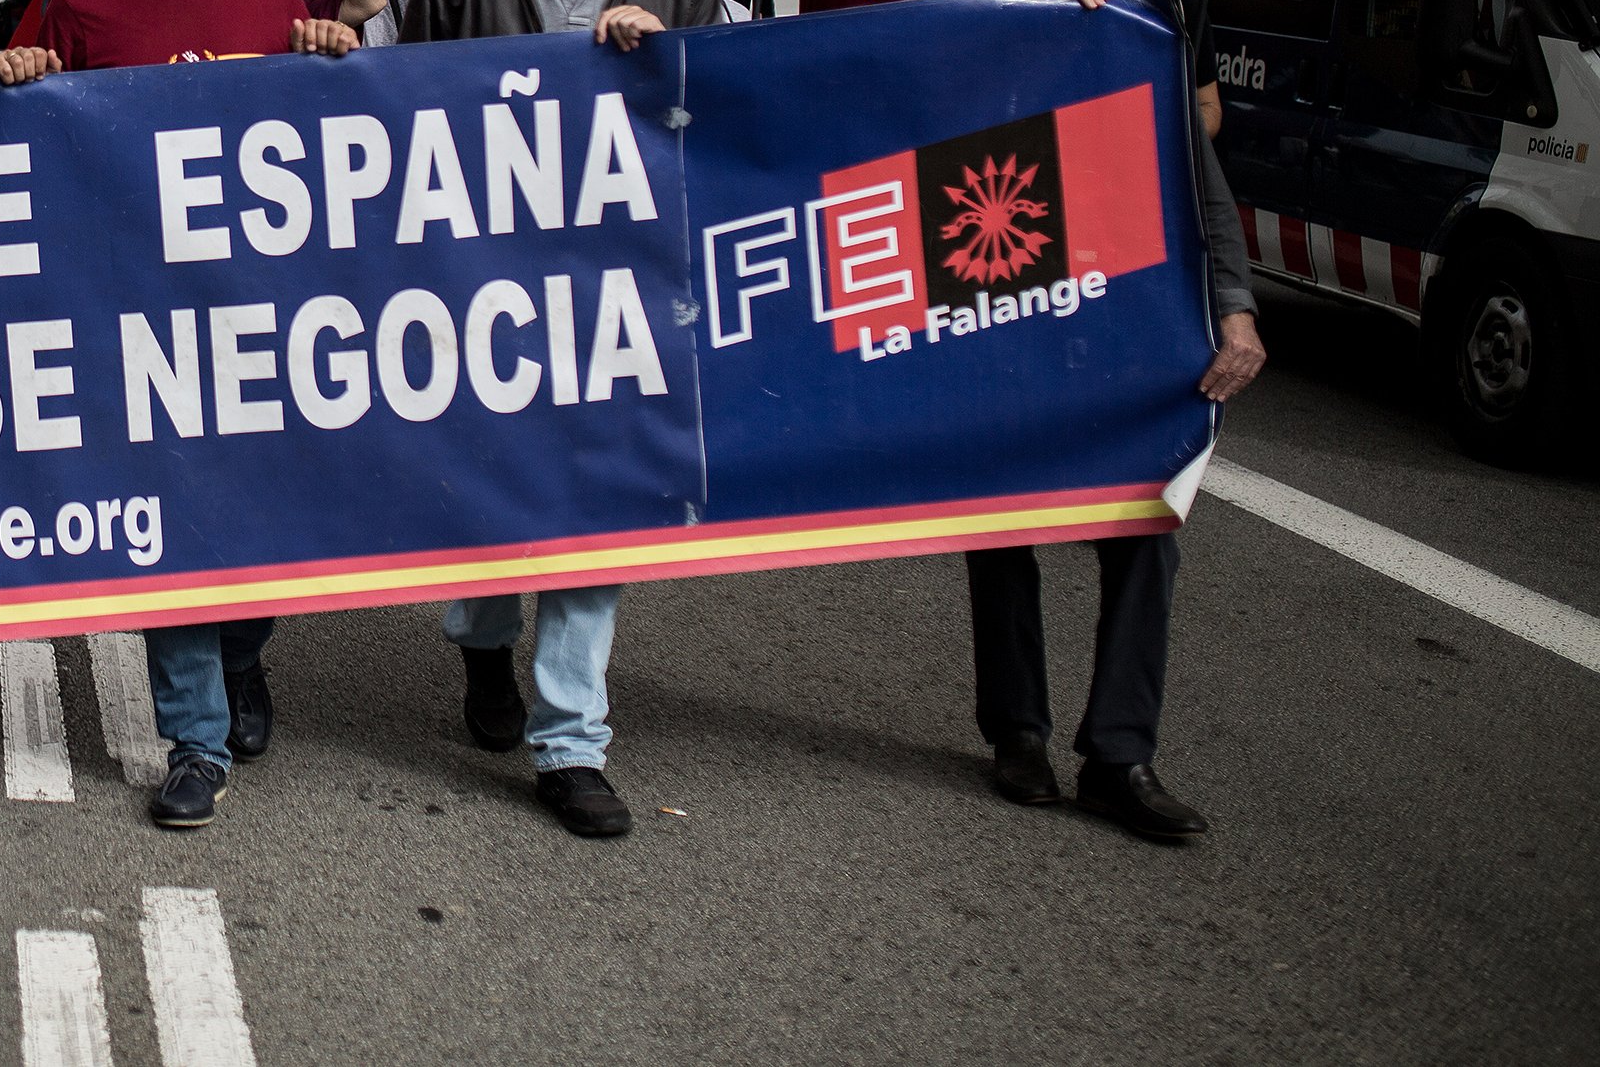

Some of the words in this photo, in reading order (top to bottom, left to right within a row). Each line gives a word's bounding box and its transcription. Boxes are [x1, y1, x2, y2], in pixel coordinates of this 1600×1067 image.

[1215, 44, 1266, 91] adra
[155, 68, 658, 263] ESPAÑA
[1527, 136, 1574, 160] policia
[702, 180, 914, 349] FE
[859, 323, 911, 362] La
[925, 269, 1107, 344] Falange
[120, 267, 668, 443] NEGOCIA
